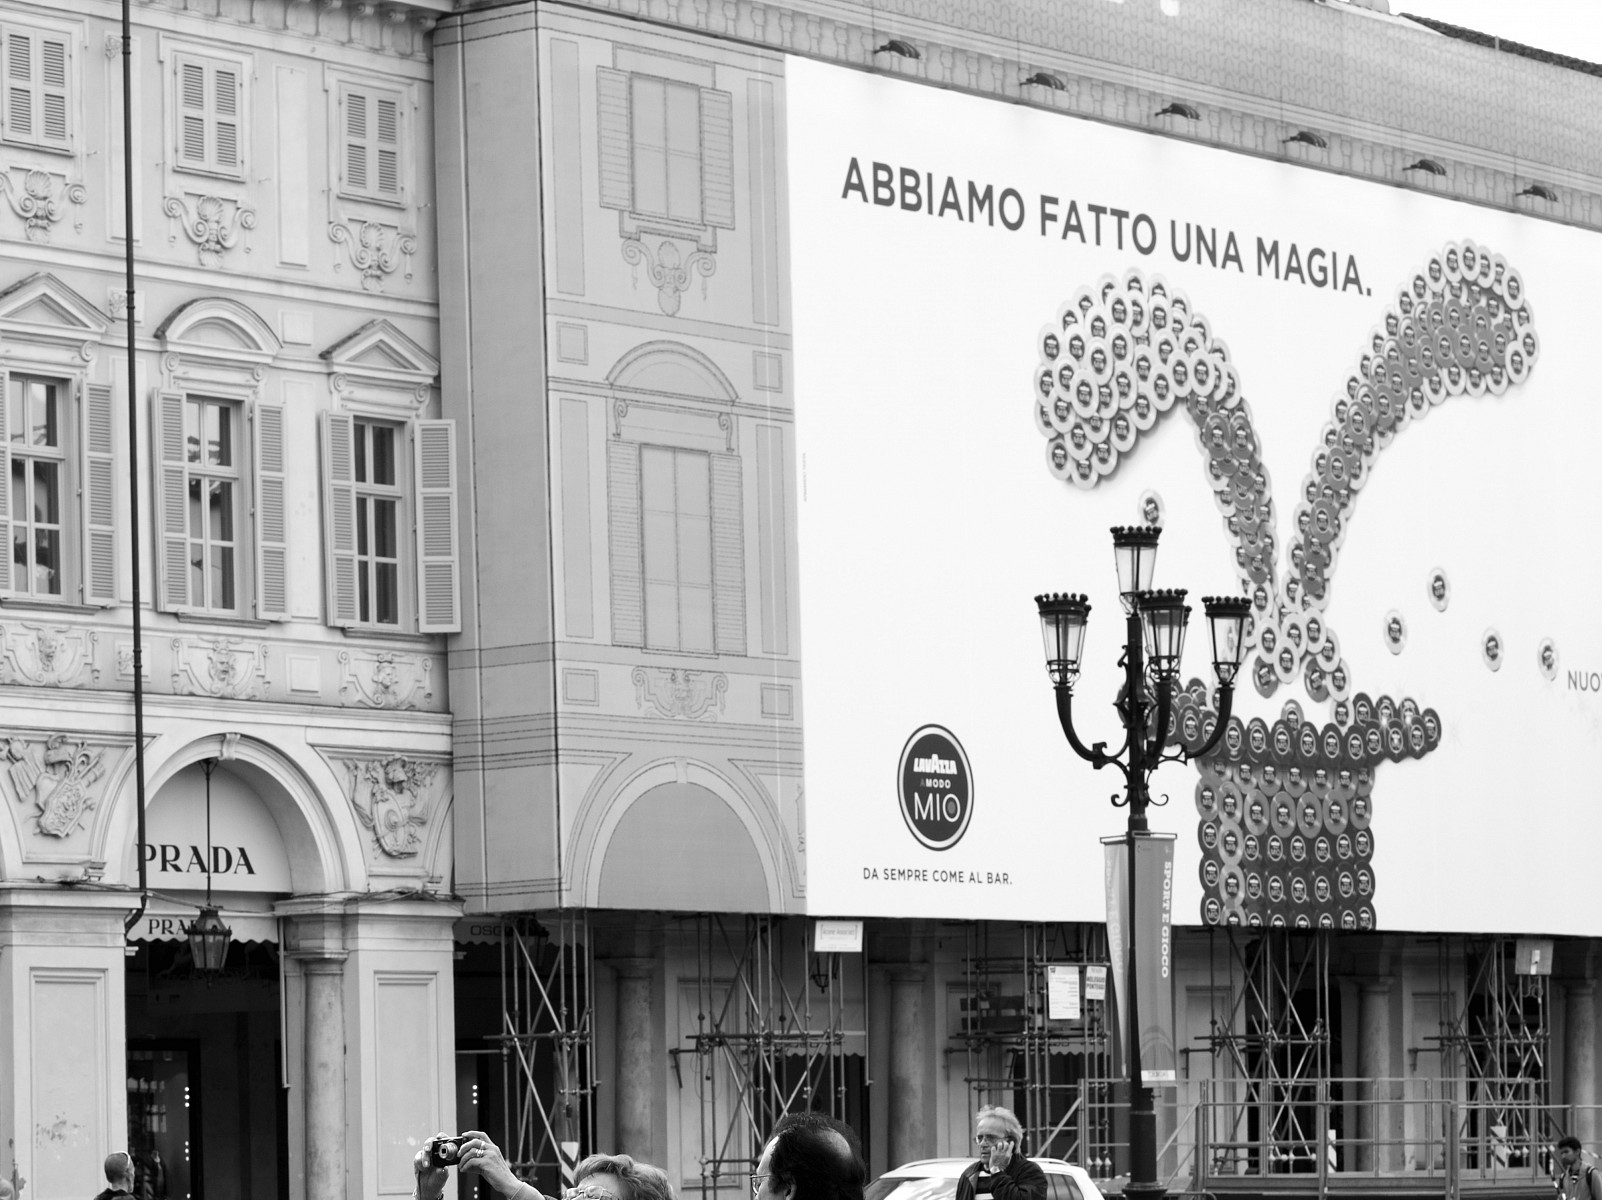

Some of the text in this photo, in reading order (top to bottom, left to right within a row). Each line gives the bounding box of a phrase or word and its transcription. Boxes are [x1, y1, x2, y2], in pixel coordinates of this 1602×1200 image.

[841, 156, 1372, 297] ABBIAMO FATTO UNA MAGIA.
[1567, 669, 1602, 693] NUO
[913, 753, 958, 775] LAVAZZA
[913, 791, 961, 823] MIO
[135, 843, 257, 875] PRADA
[863, 867, 1013, 885] DA SEMPRE COME AL BAR.
[148, 918, 196, 935] PRA
[1161, 861, 1172, 978] SPORT E GIOCO
